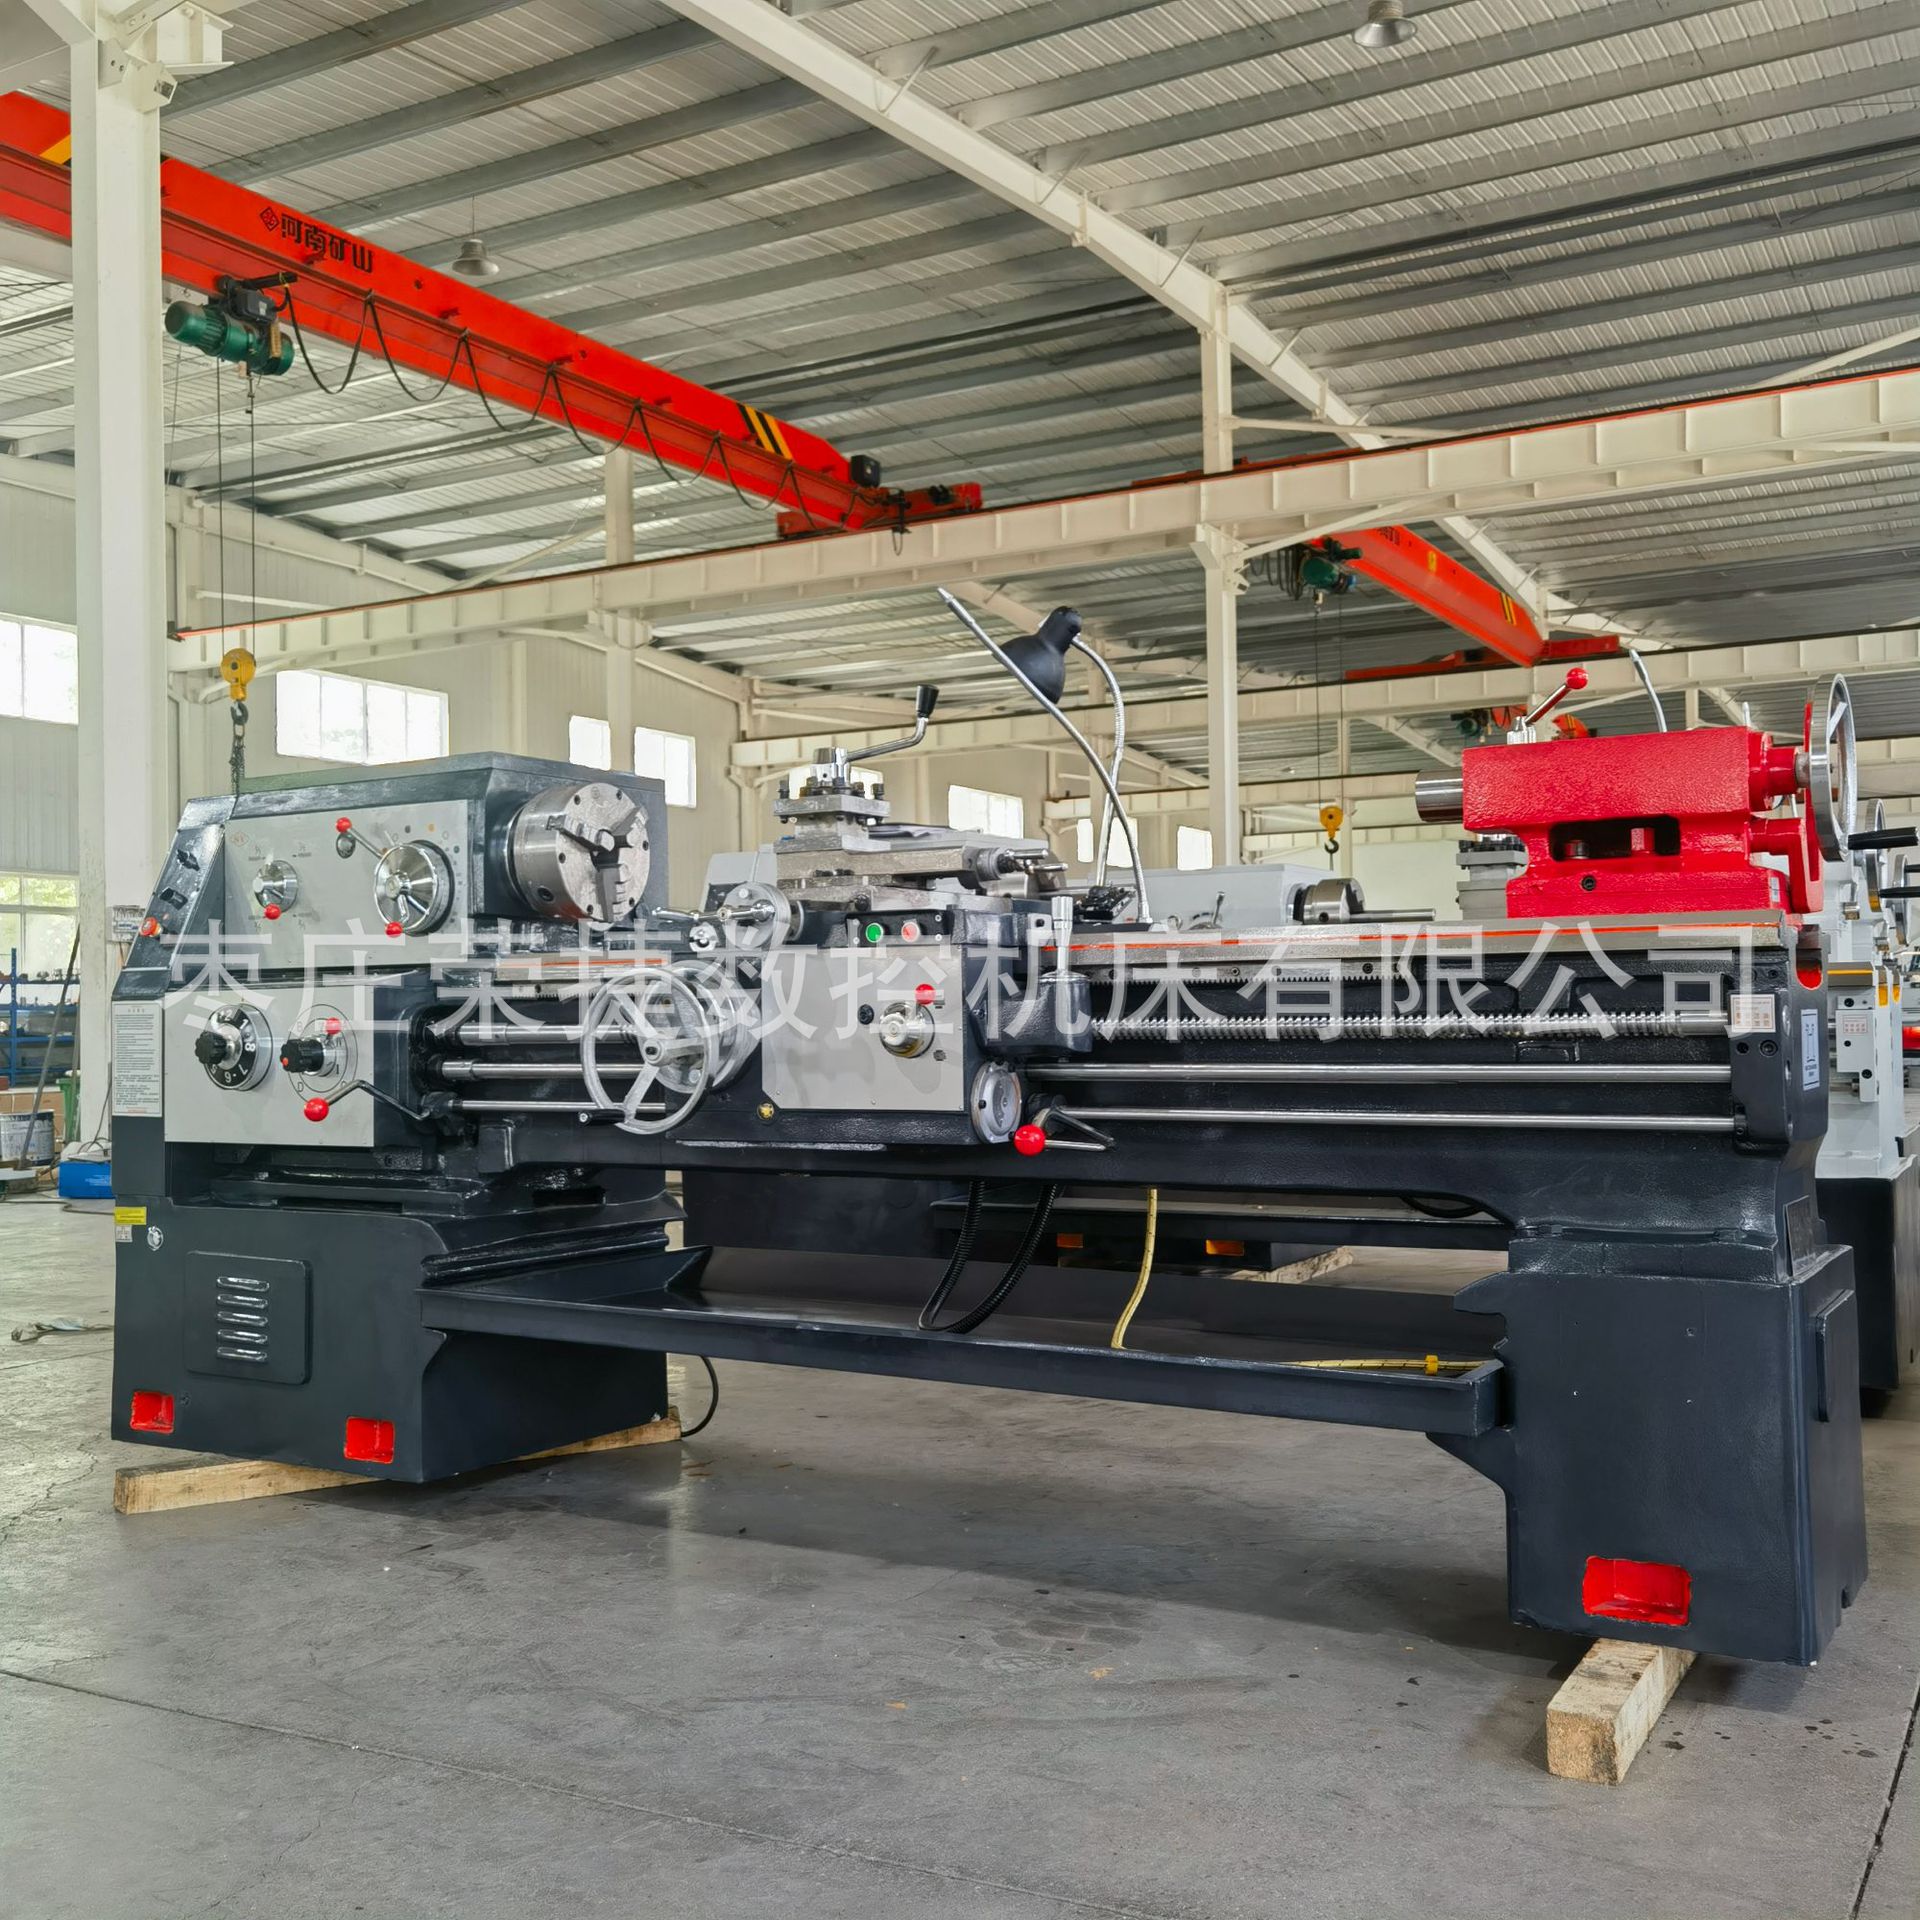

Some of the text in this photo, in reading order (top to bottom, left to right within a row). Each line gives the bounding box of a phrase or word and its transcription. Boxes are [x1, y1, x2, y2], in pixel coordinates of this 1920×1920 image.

[281, 211, 373, 273] 河南矿山
[244, 1042, 256, 1052] 8
